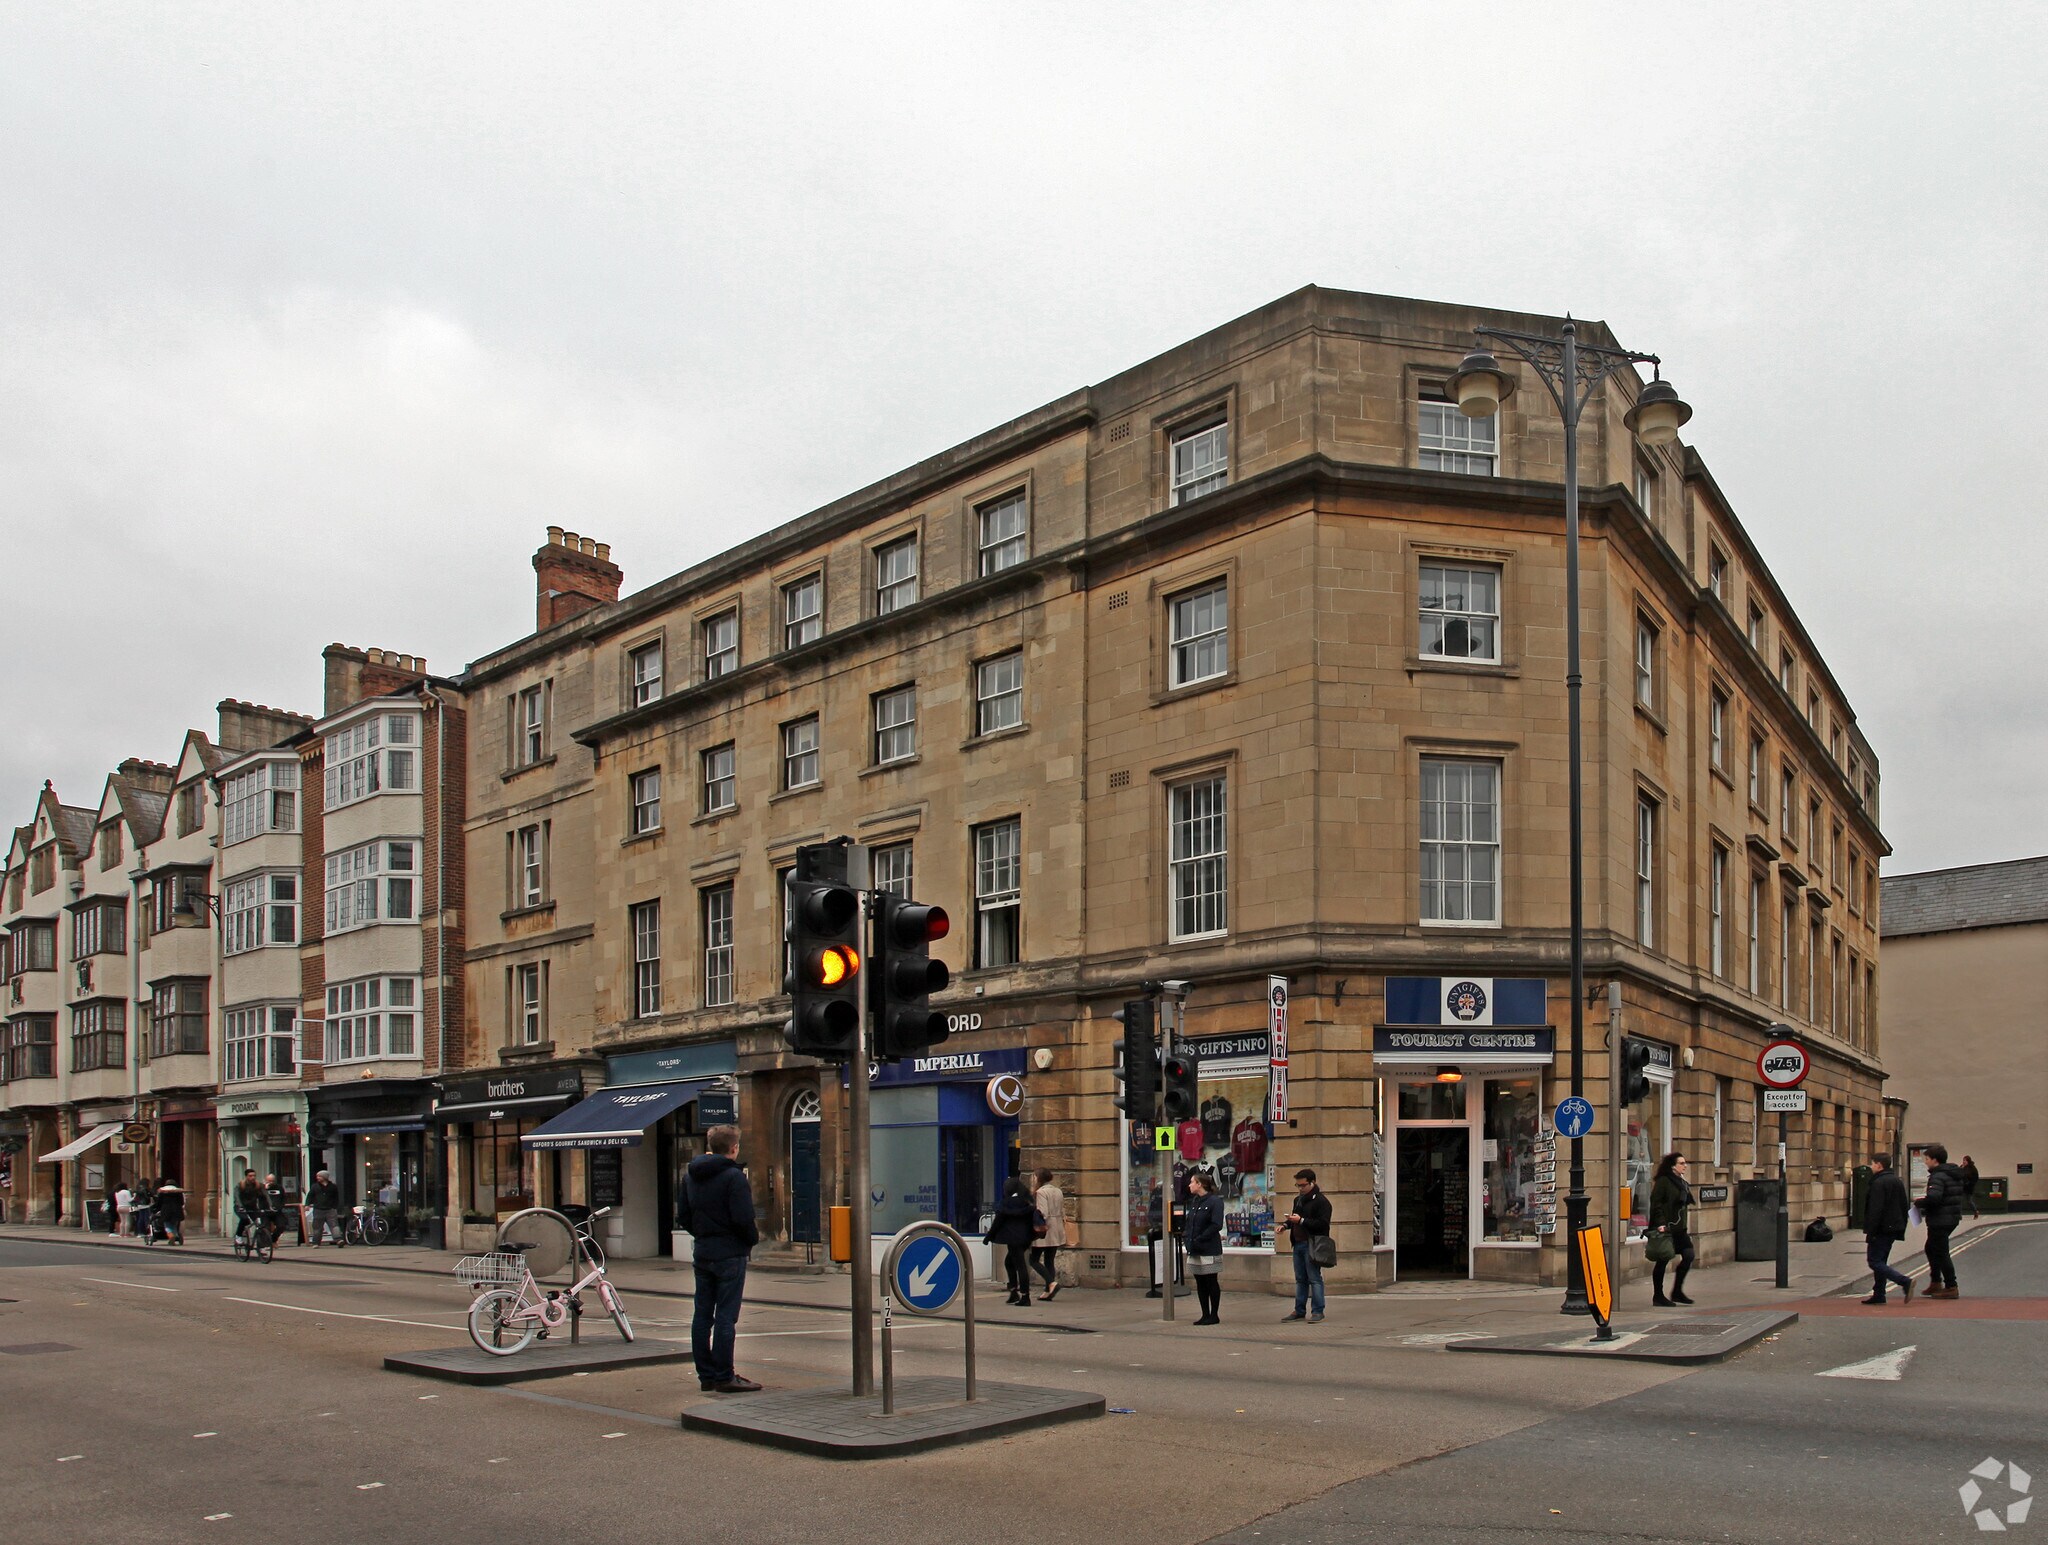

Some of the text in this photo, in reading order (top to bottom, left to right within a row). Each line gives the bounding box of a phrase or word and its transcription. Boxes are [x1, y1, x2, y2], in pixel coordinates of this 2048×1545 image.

[1449, 983, 1485, 1005] UNIGIFTS
[947, 1013, 982, 1032] ORD
[1199, 1037, 1267, 1055] GIFTS-INFO
[1390, 1033, 1536, 1047] TOURIST CENTRE
[658, 1059, 680, 1067] TAYLORS
[914, 1053, 984, 1072] IMPERIAL
[488, 1080, 525, 1097] brothers
[557, 1079, 579, 1089] AVEDA
[614, 1092, 663, 1104] TAYLORS
[231, 1102, 260, 1113] PODAROK
[918, 1185, 936, 1193] SAFE
[904, 1195, 936, 1203] RELIABLE
[920, 1205, 937, 1213] FAST
